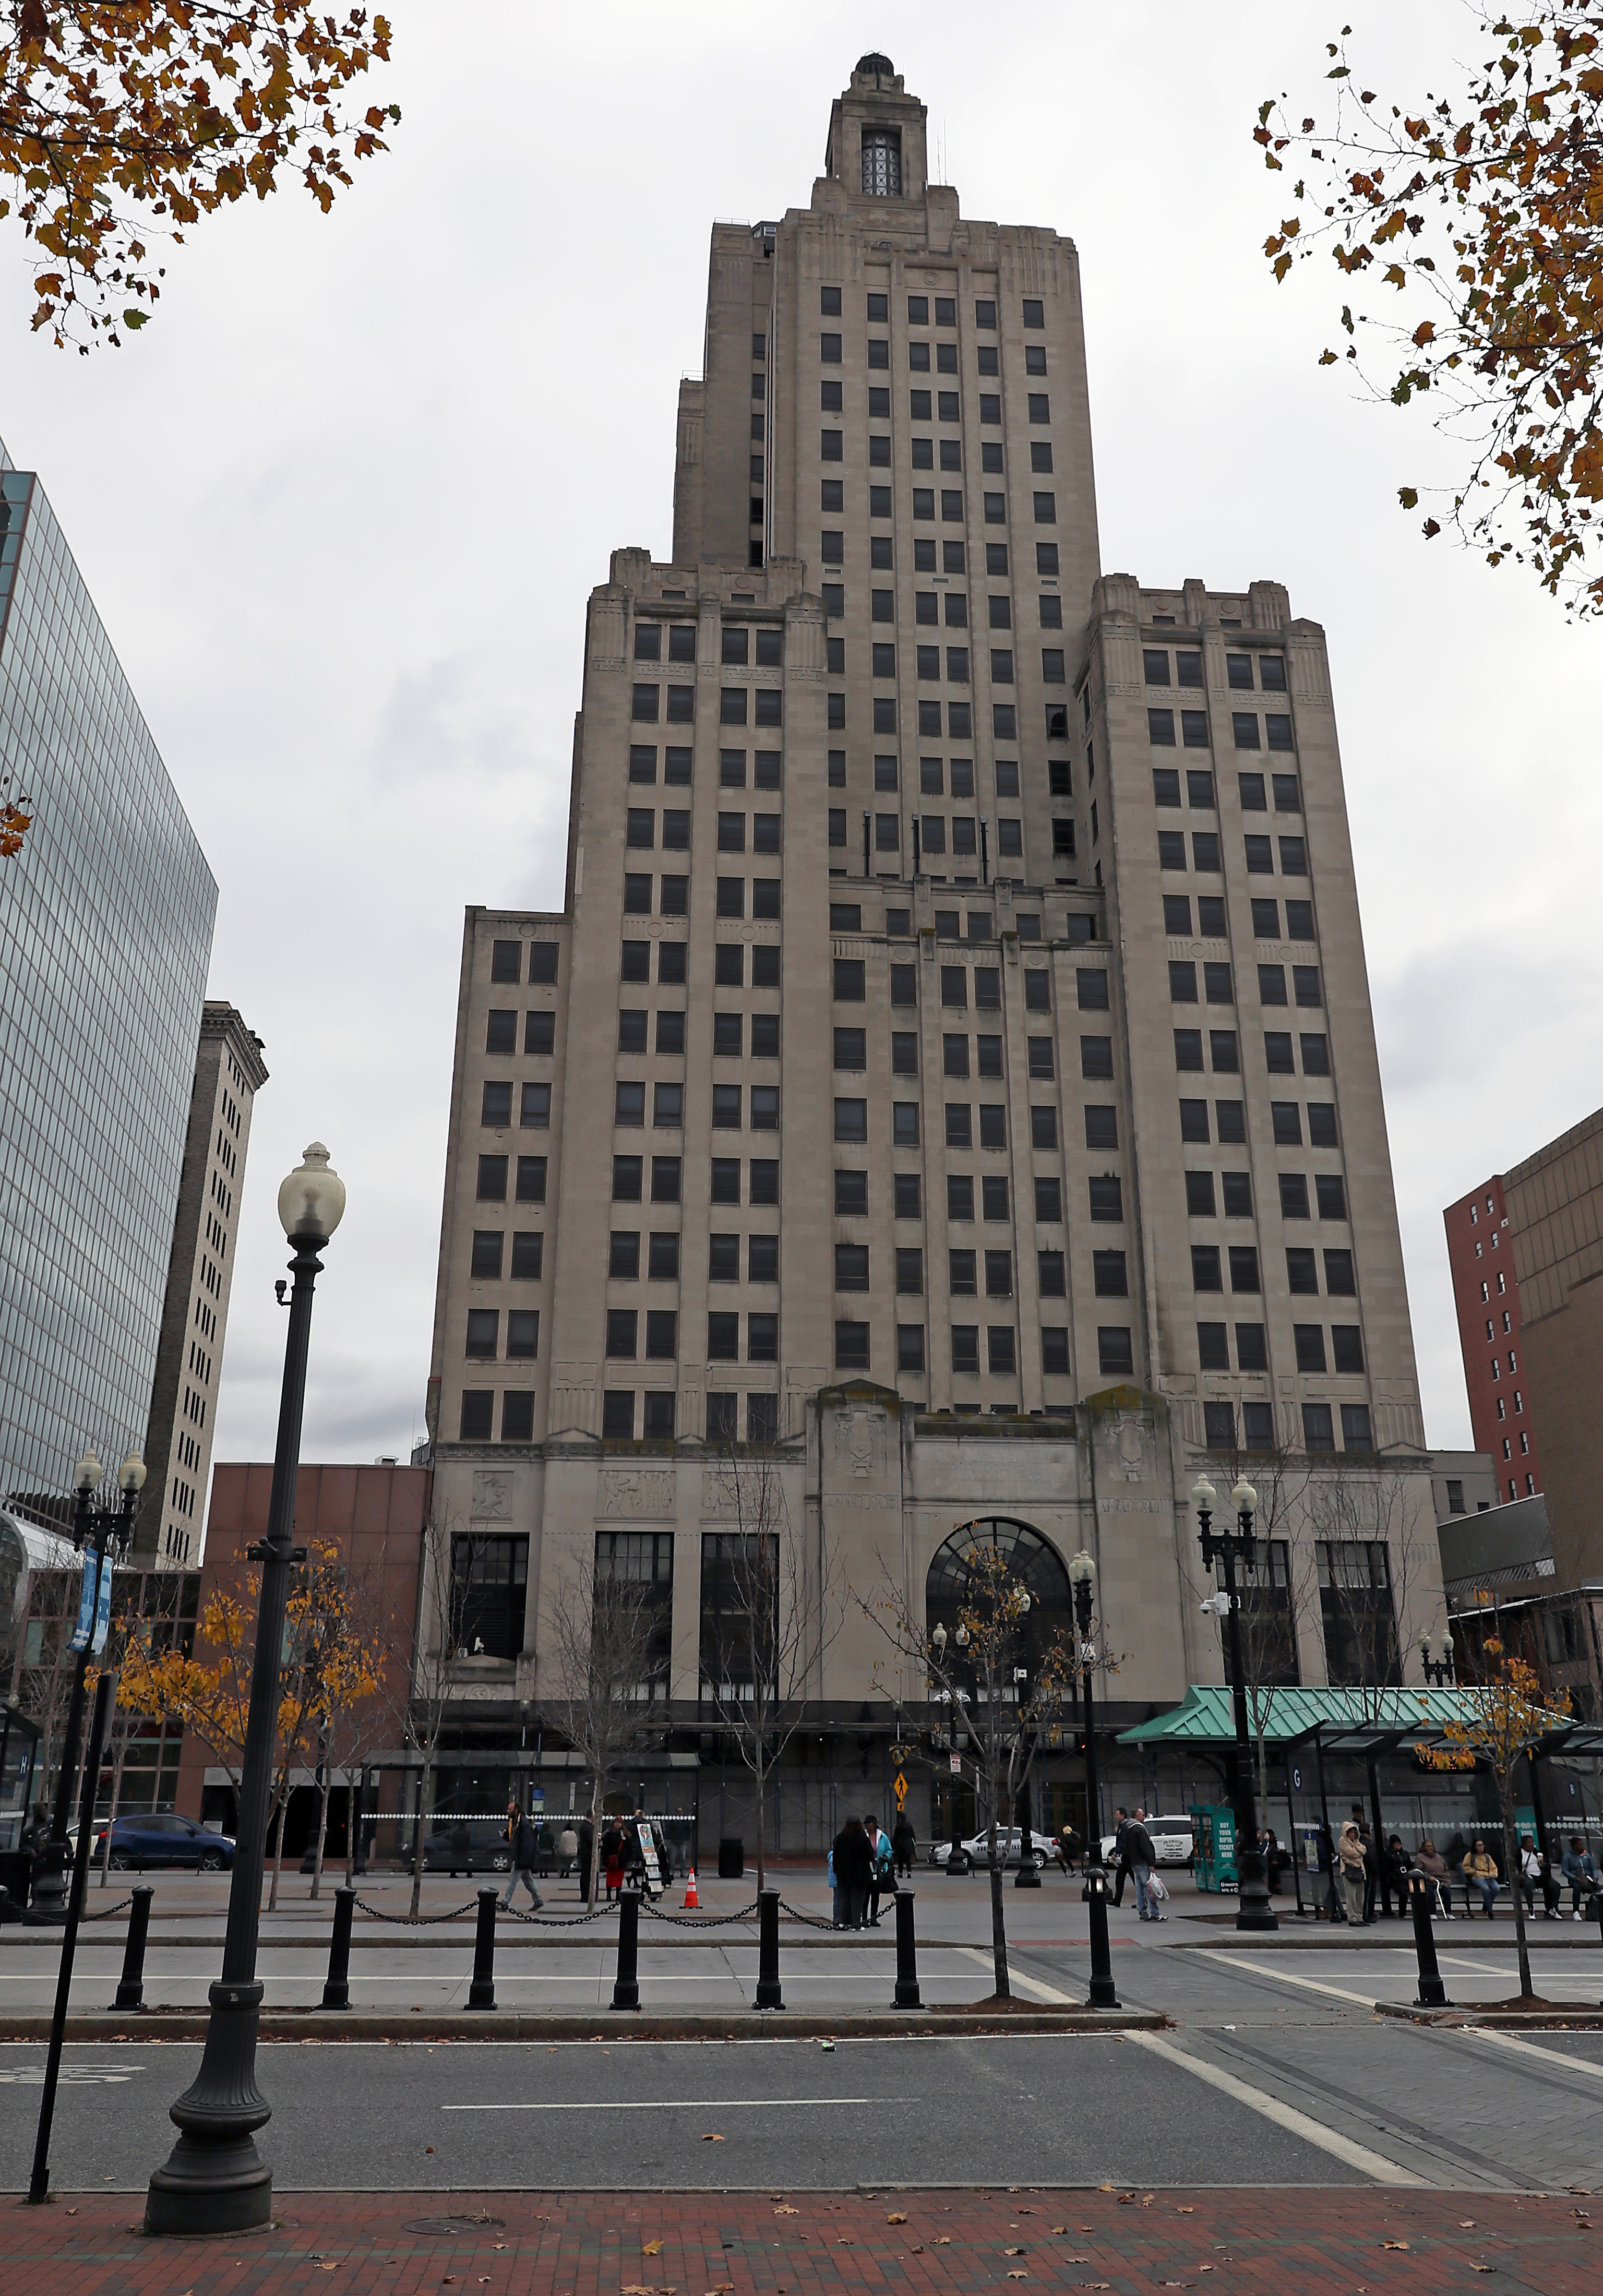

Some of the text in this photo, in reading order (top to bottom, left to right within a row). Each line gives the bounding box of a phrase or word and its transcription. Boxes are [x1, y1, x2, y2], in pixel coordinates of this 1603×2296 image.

[20, 1755, 28, 1774] H
[1294, 1769, 1300, 1787] G
[1570, 1784, 1575, 1795] B
